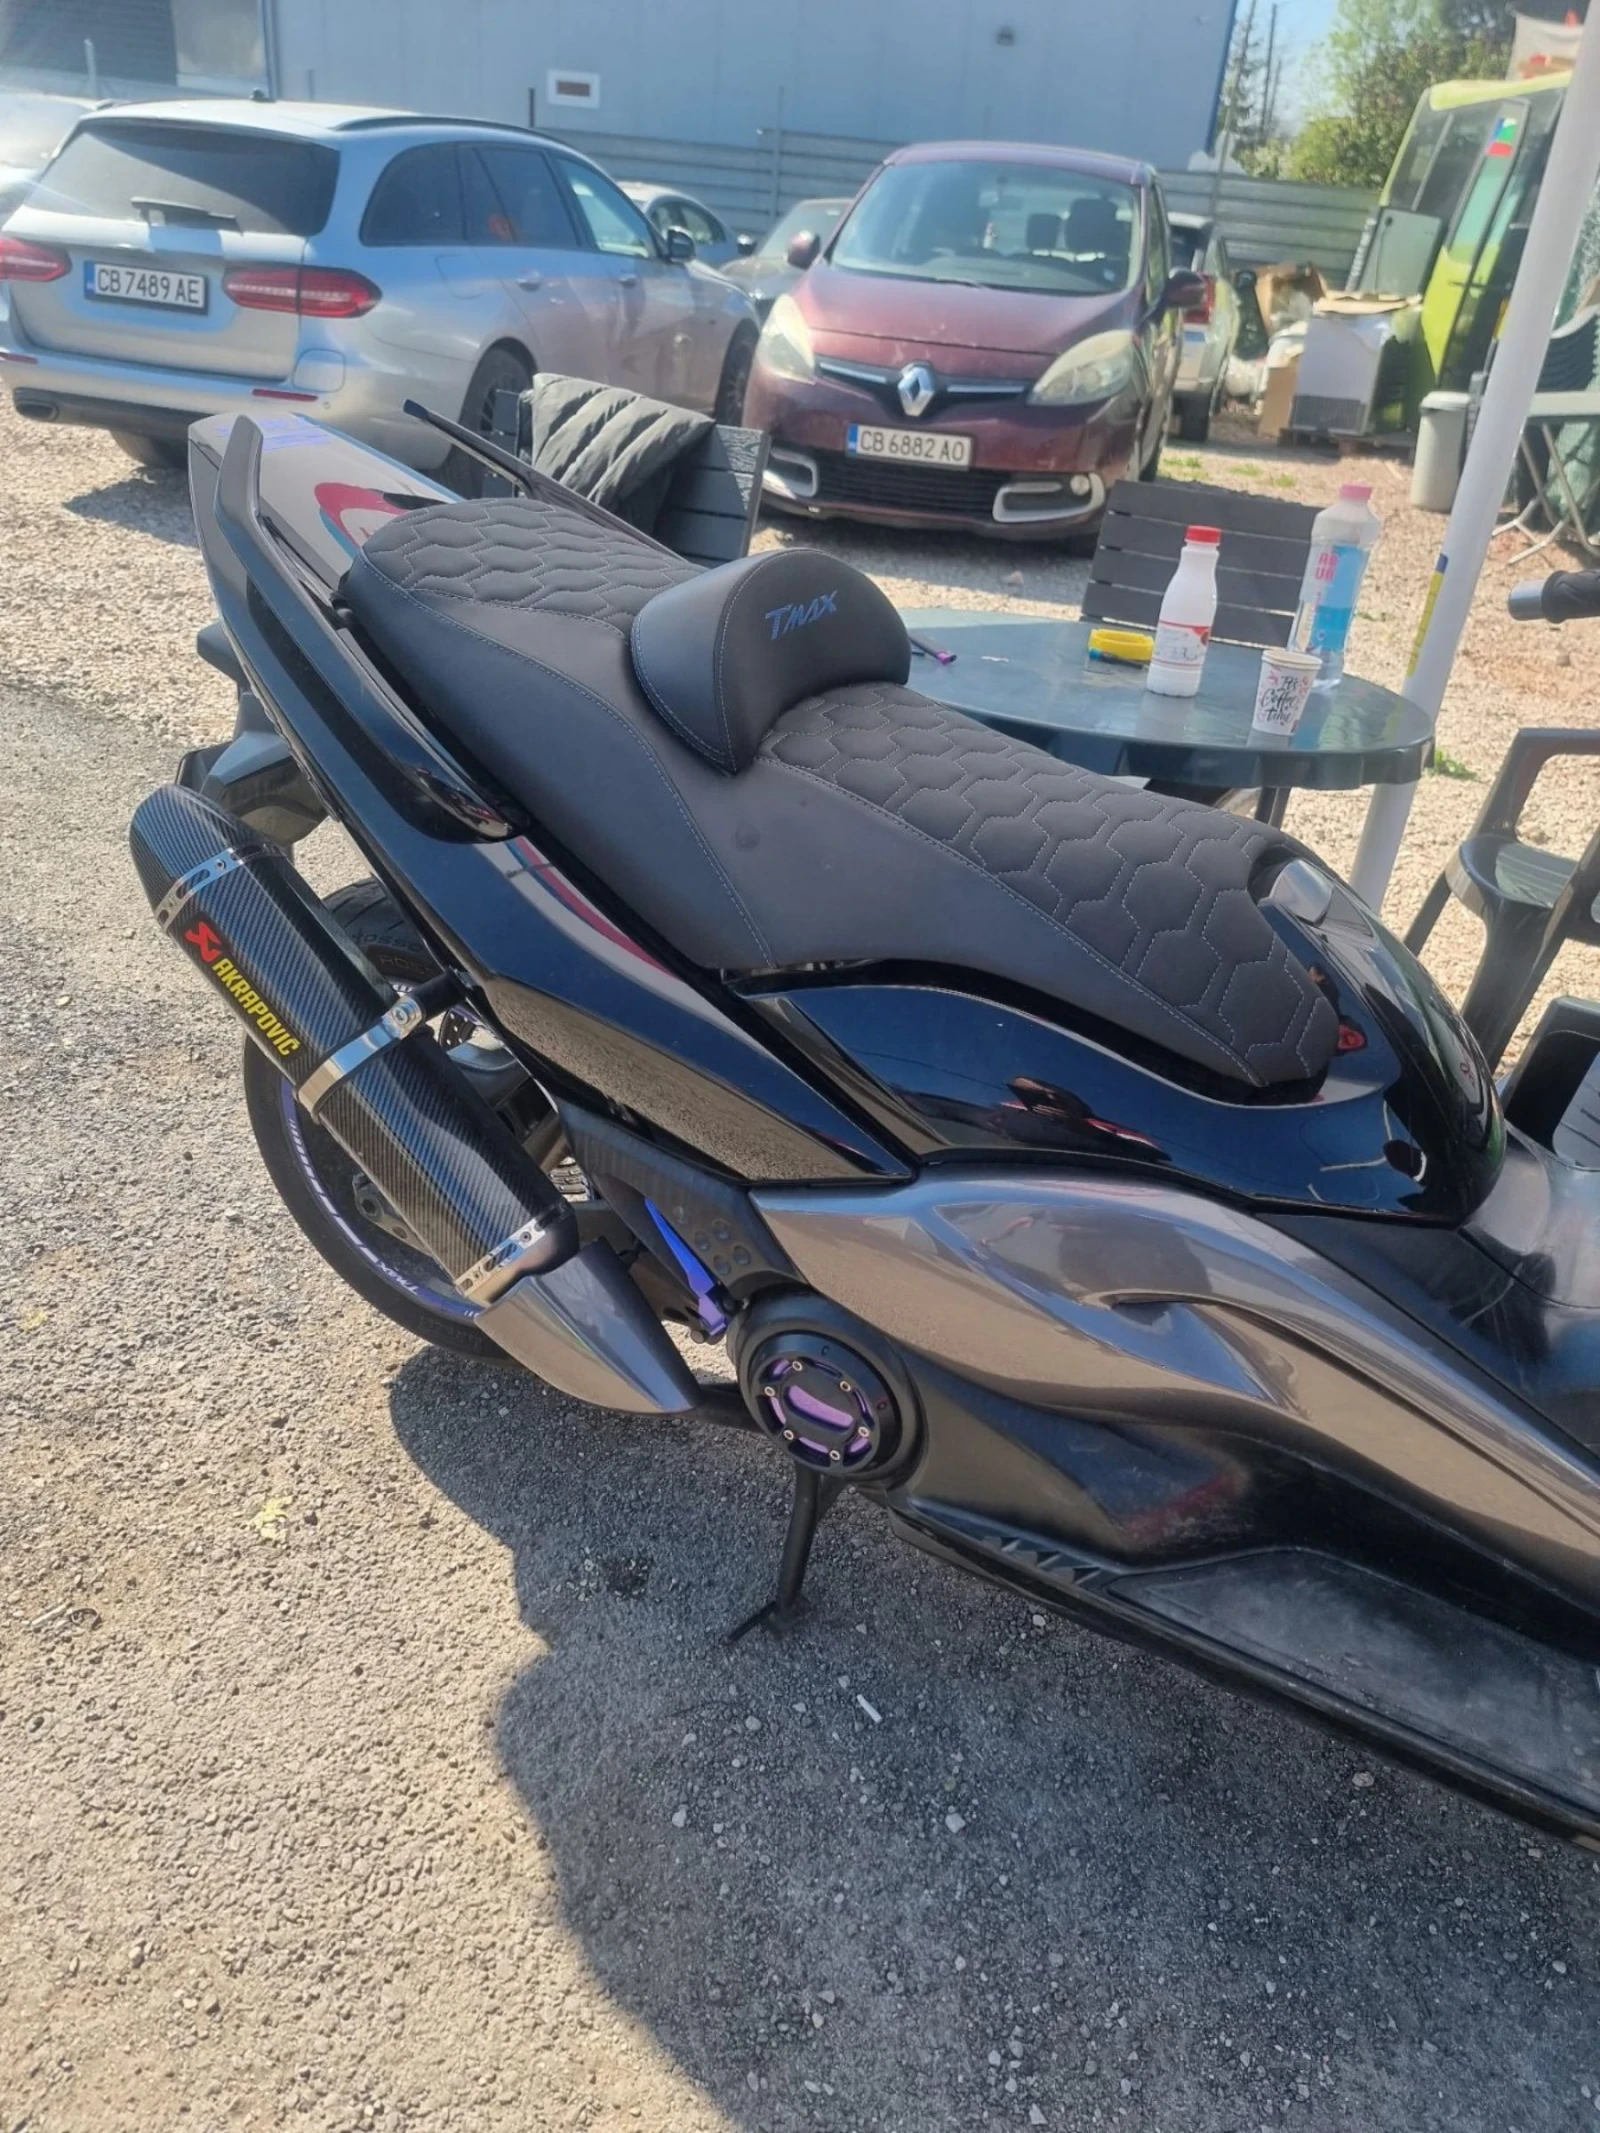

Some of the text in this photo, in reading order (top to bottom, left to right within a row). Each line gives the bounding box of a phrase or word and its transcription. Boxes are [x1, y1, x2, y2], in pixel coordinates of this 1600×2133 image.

[98, 268, 200, 305] CB 7489 AE
[861, 430, 965, 462] CB 6882 AO
[765, 590, 838, 640] TMAX
